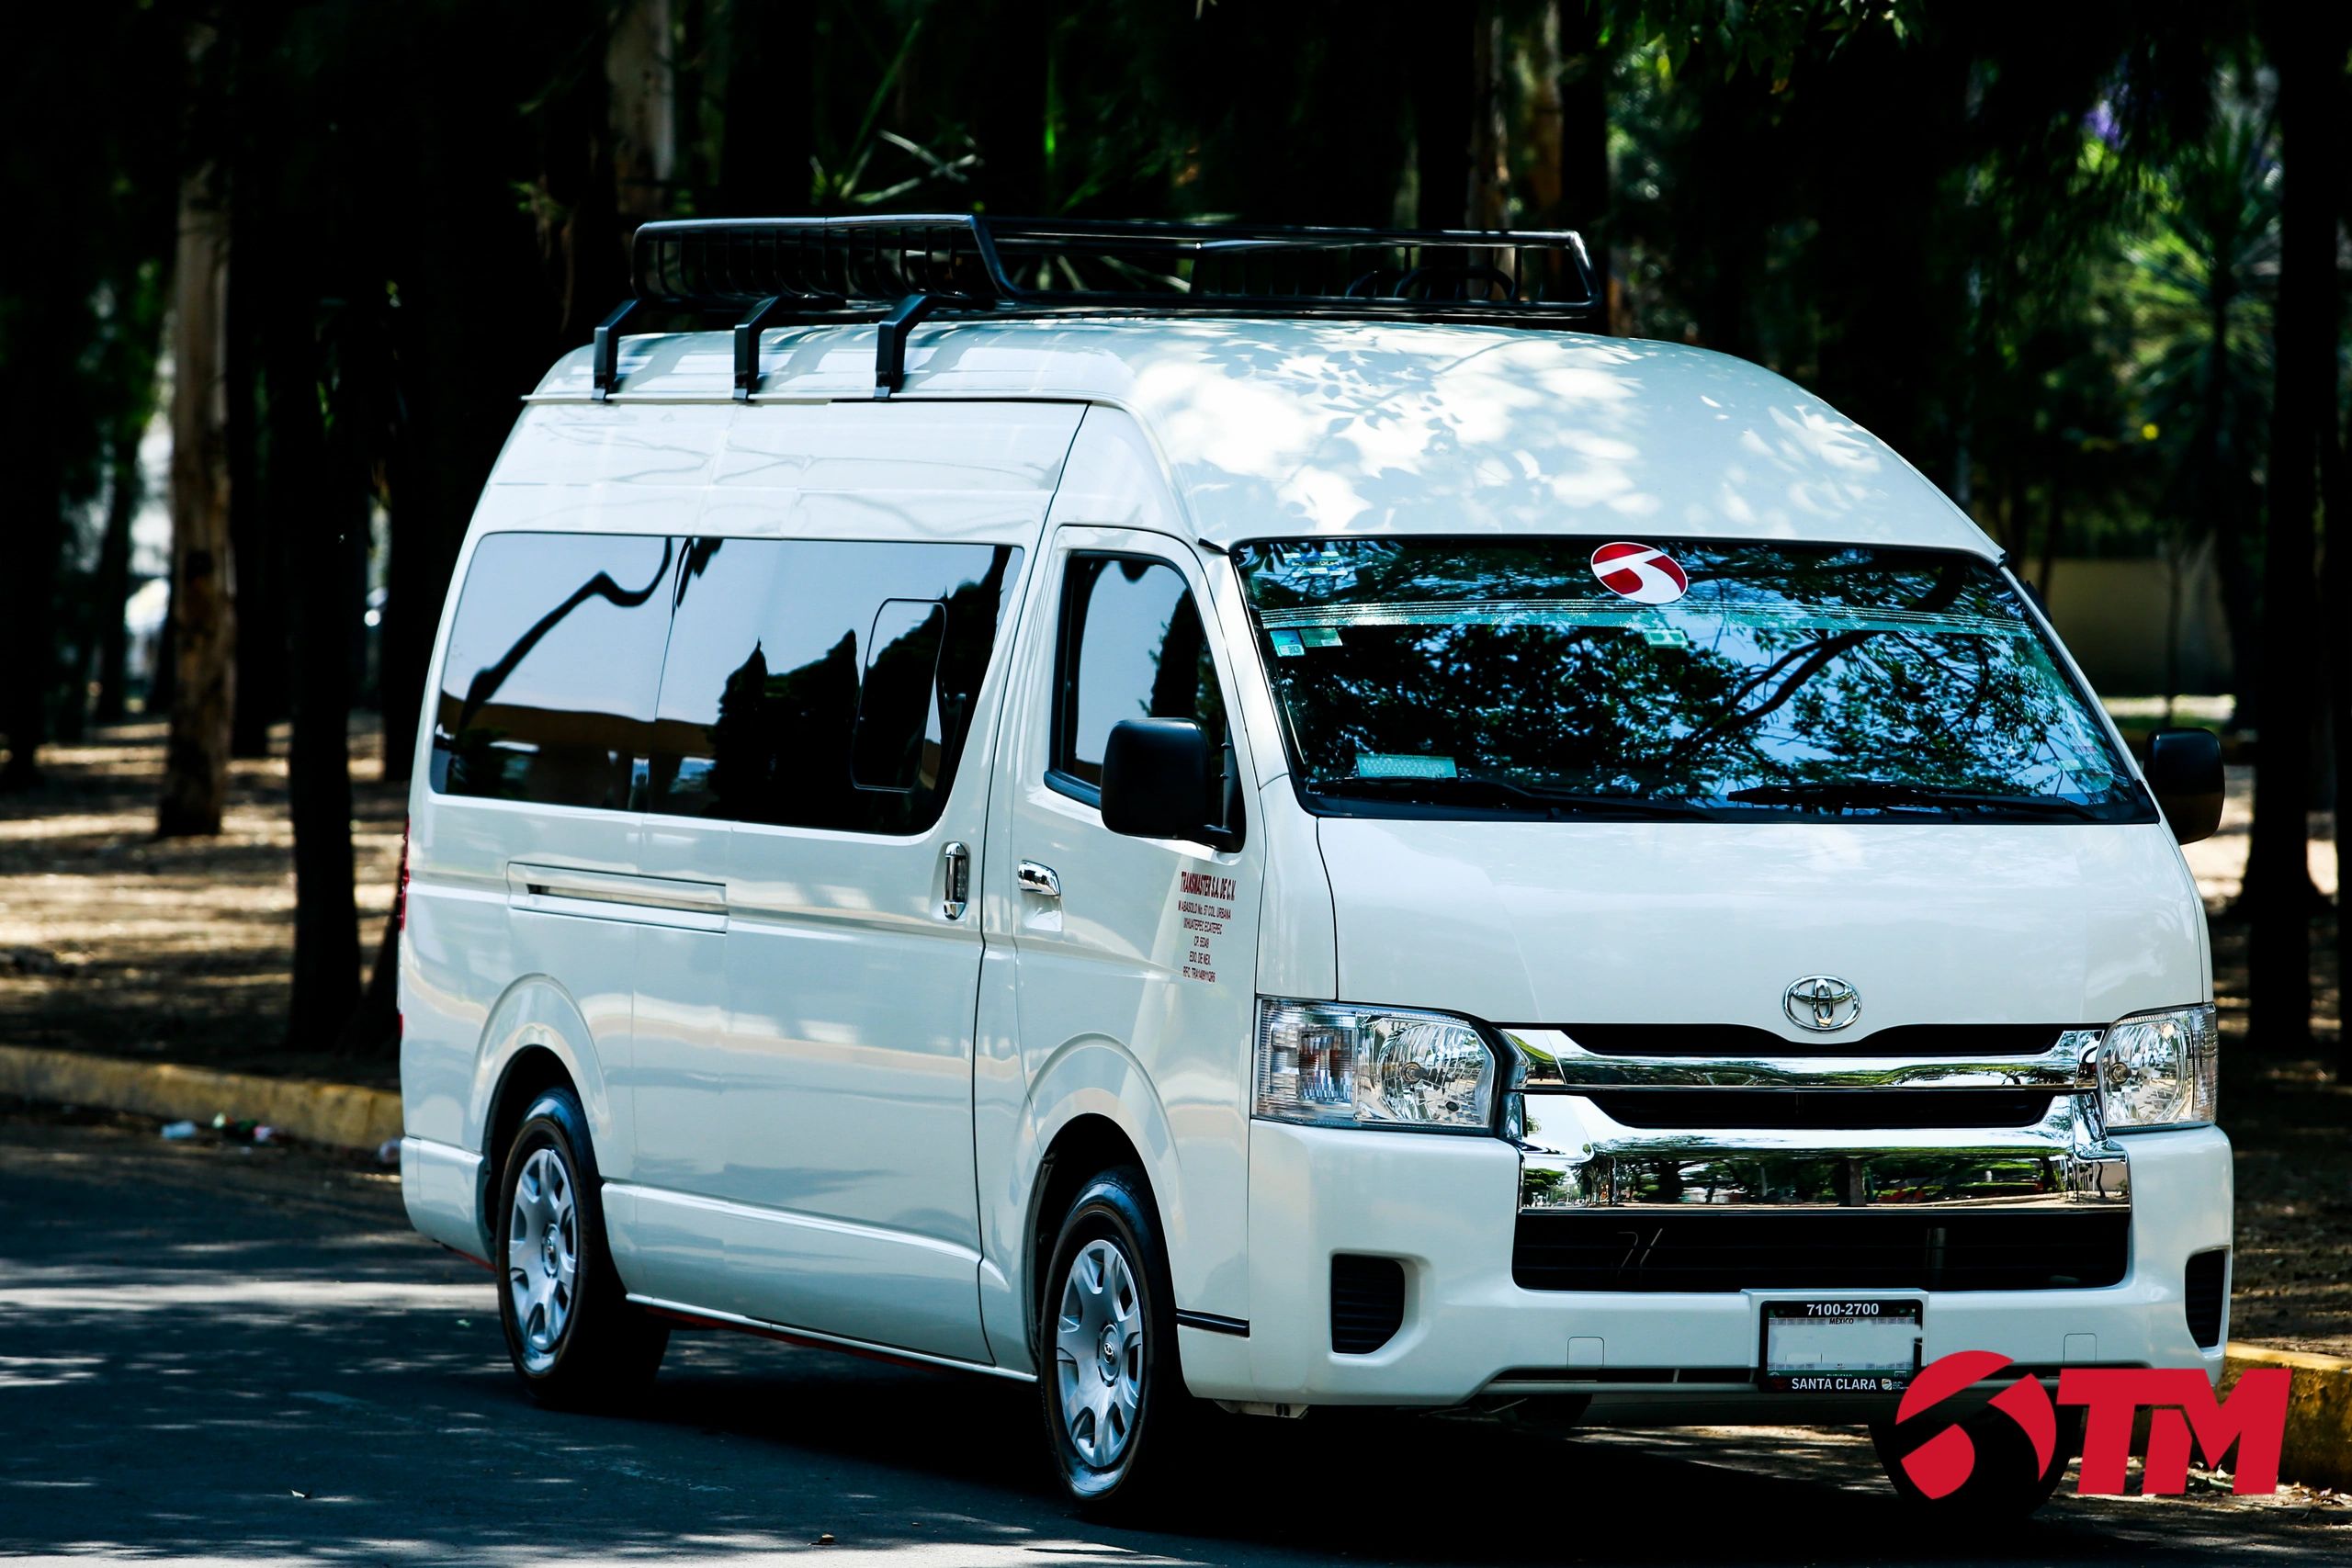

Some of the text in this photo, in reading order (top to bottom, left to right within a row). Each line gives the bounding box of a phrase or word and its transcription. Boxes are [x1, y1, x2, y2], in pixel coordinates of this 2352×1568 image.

[1181, 871, 1211, 897] TRANSMASTER
[1220, 878, 1227, 900] DE
[1806, 1303, 1880, 1316] 7100-2700
[1792, 1378, 1877, 1391] SANTA CLARA
